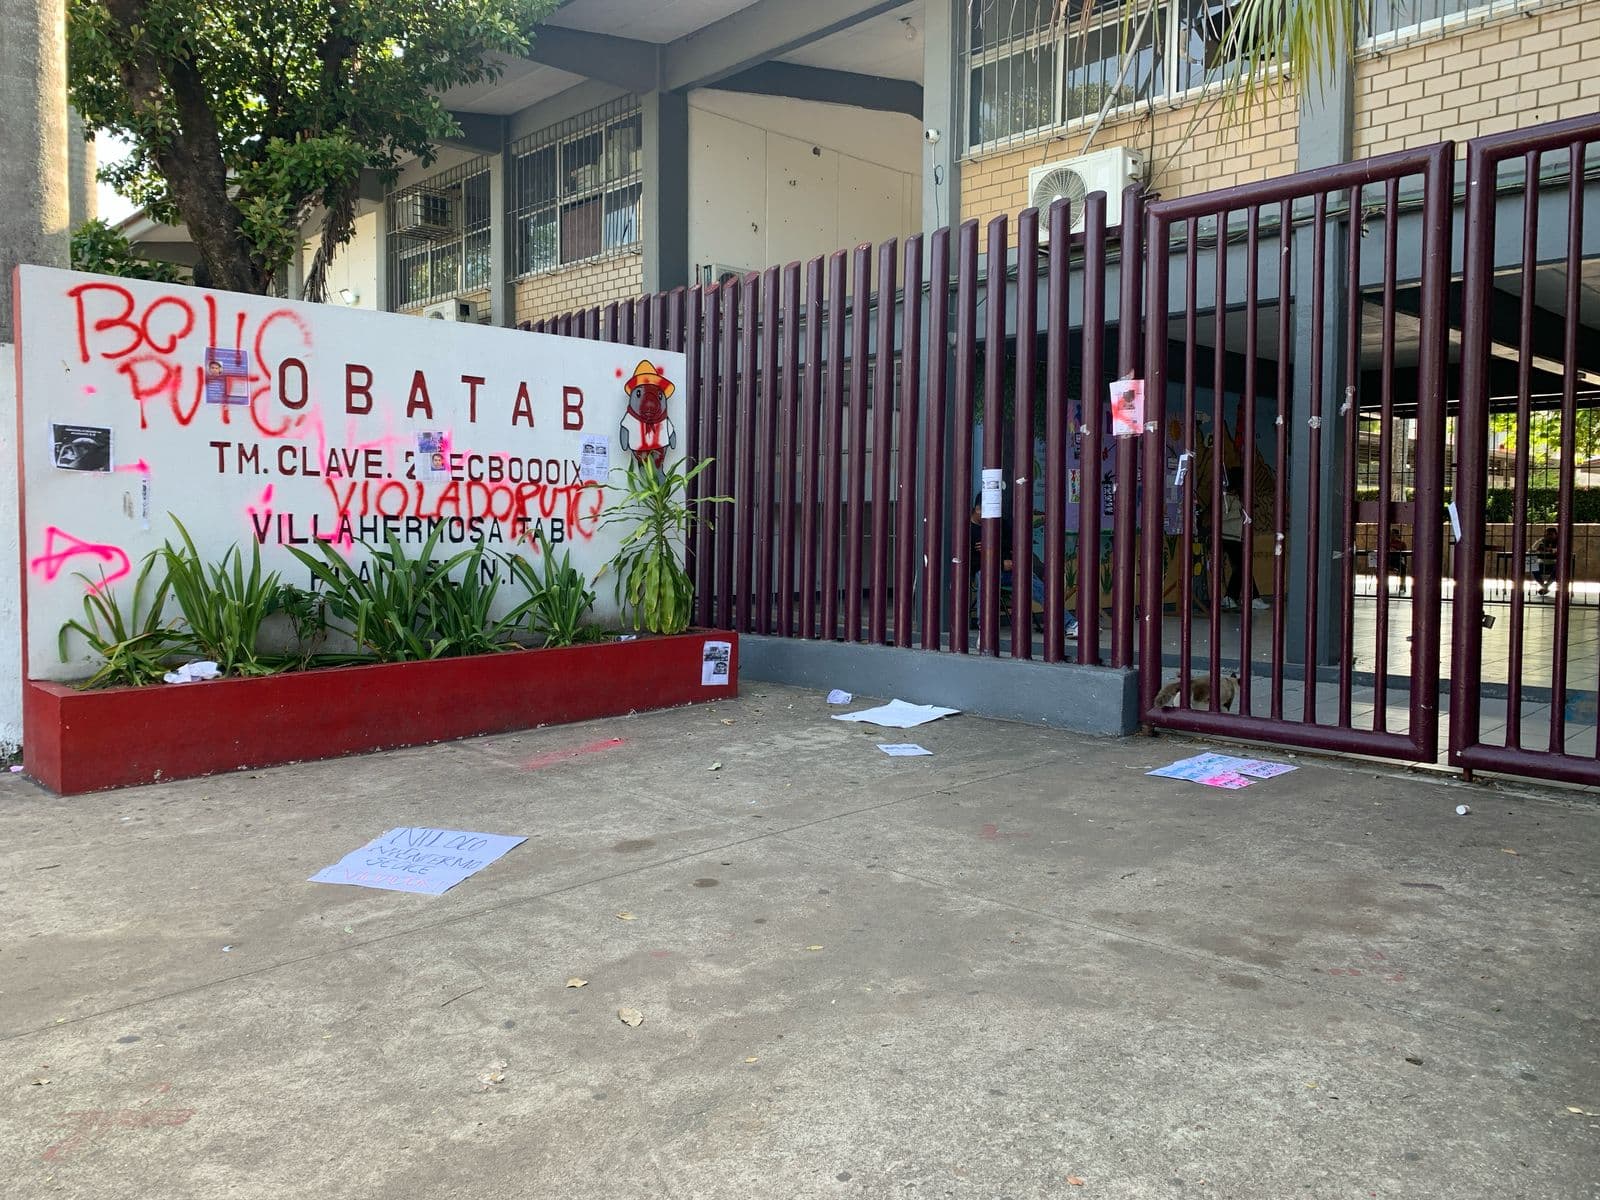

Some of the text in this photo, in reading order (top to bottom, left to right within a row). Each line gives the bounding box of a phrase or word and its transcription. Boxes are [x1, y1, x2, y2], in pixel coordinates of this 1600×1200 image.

[278, 357, 584, 431] OBATAB
[252, 513, 565, 545] VILLAHERMOSA TAB
